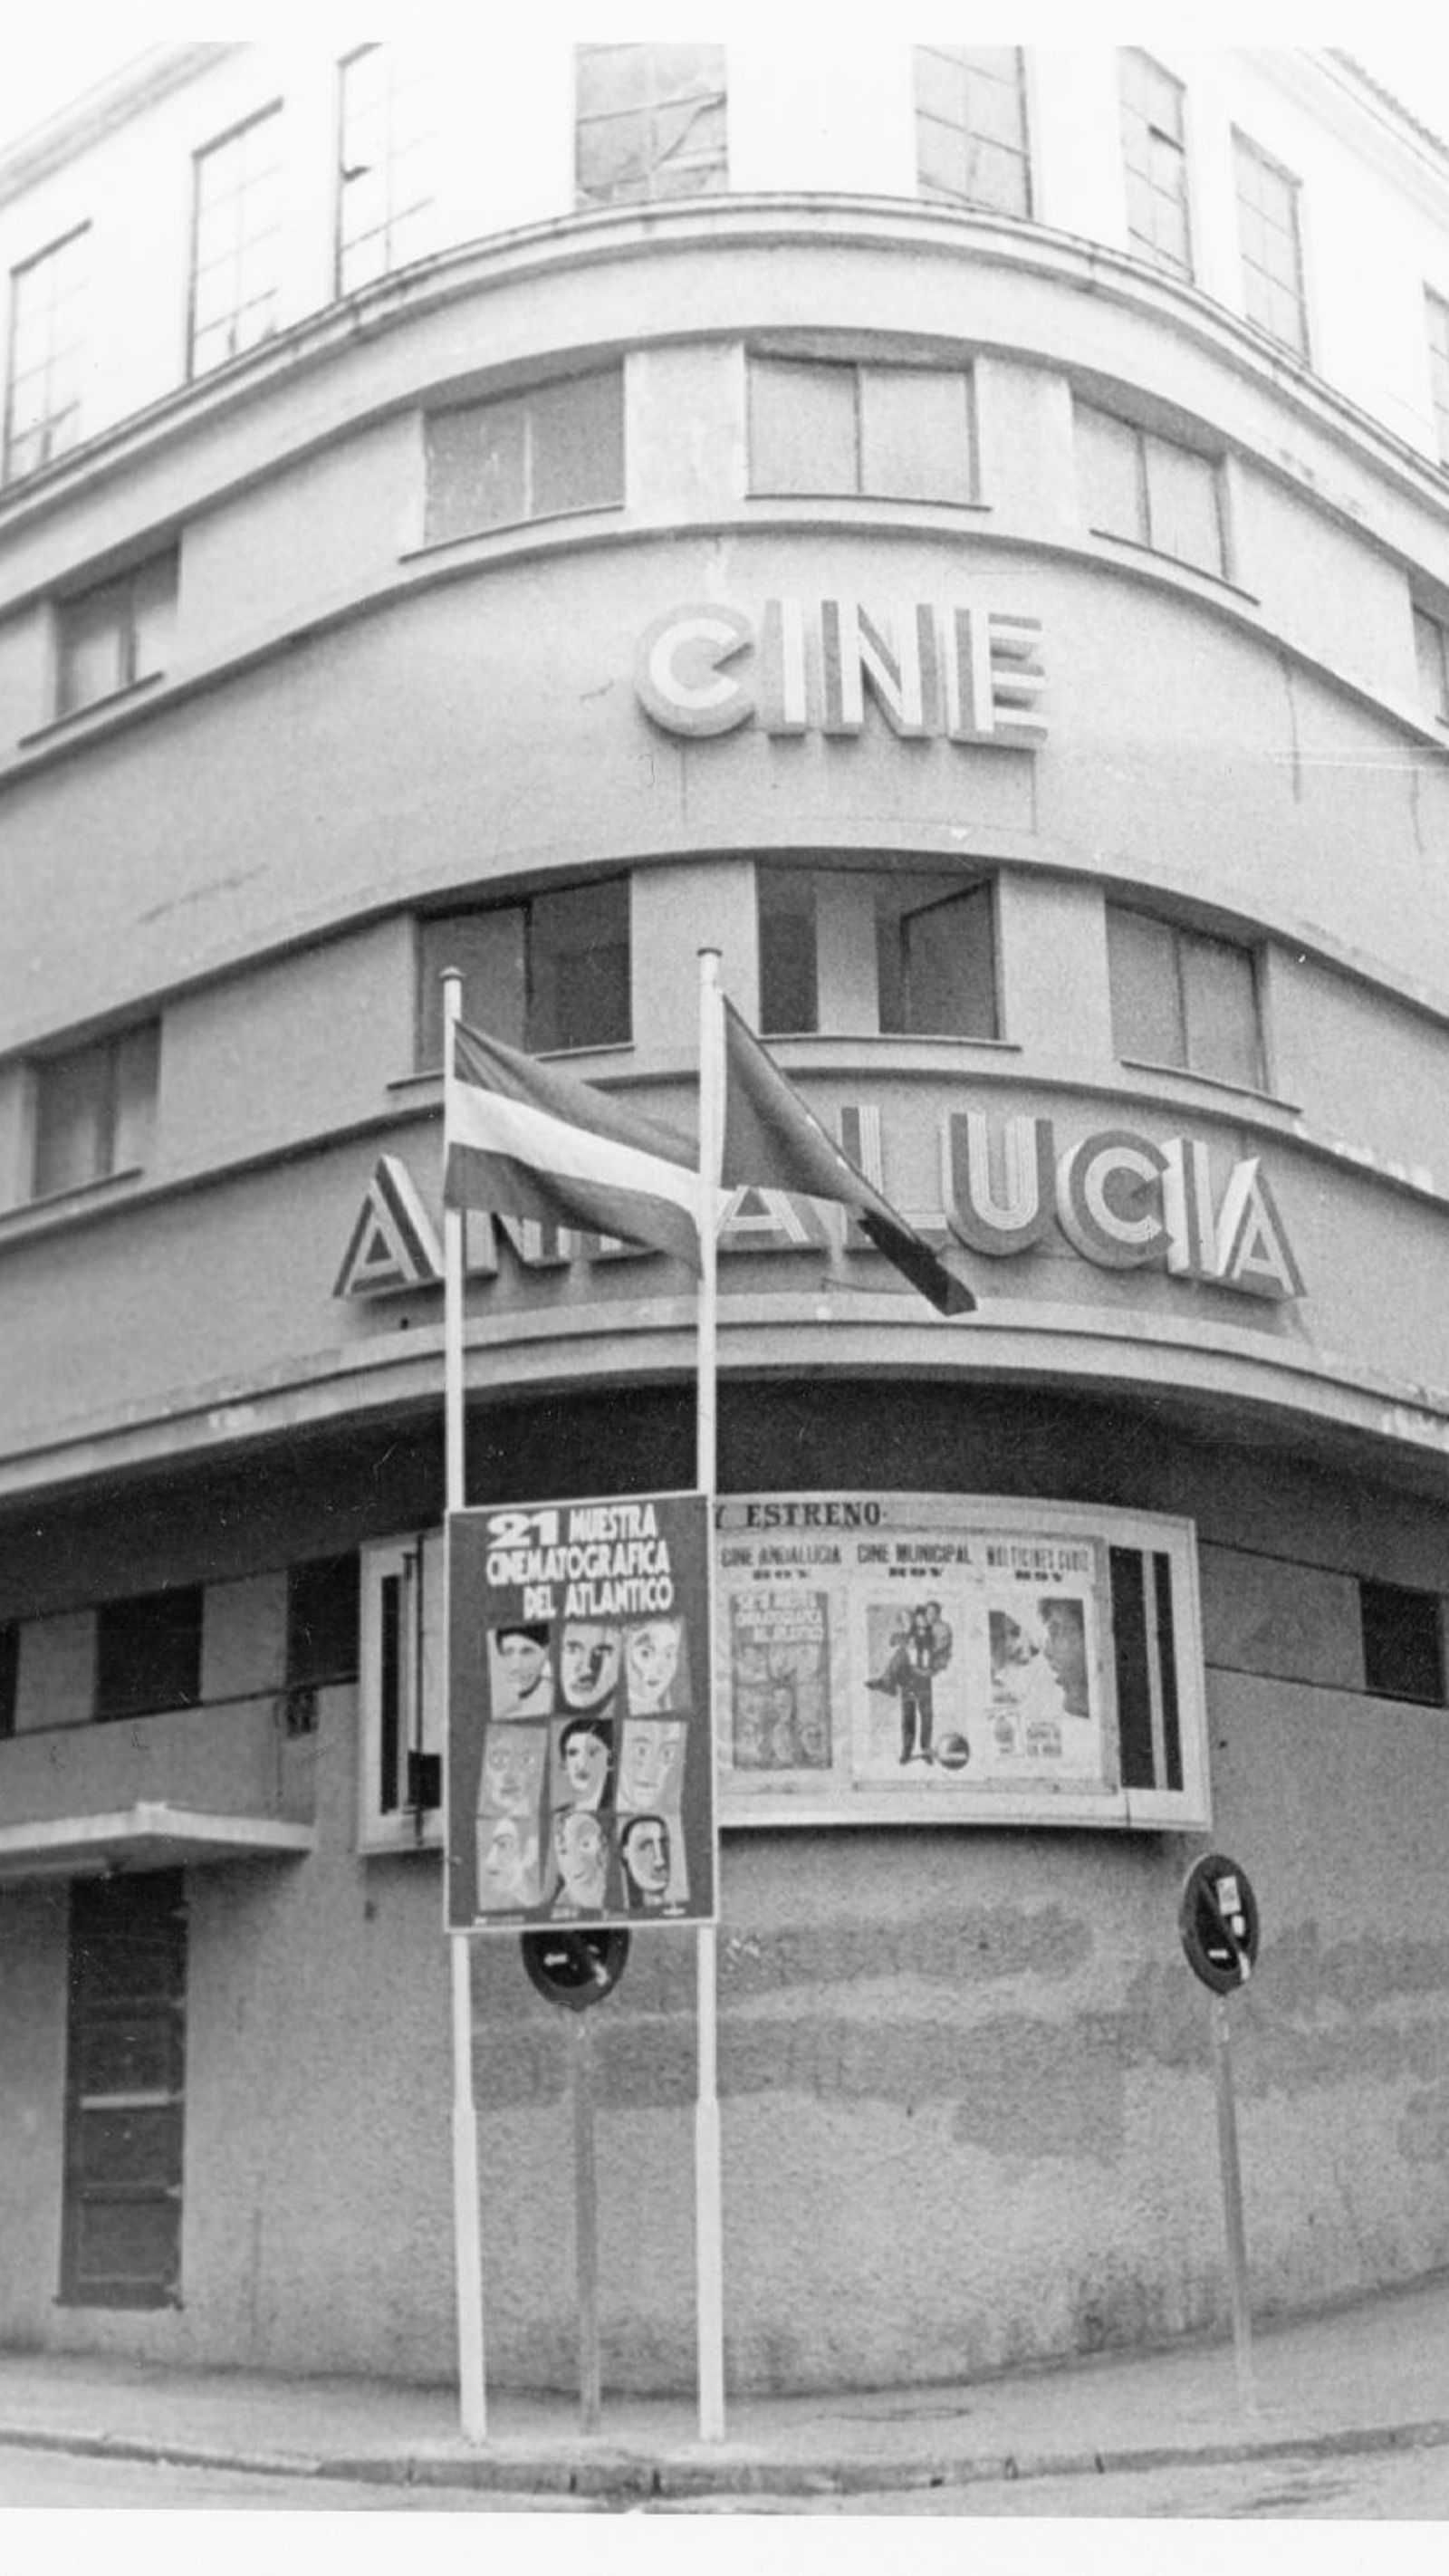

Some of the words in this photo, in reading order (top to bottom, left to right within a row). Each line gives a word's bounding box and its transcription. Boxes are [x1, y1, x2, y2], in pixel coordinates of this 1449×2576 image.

[636, 599, 1048, 747] CINE
[332, 1106, 1307, 1298] AALUCIA
[487, 1510, 559, 1550] 21
[569, 1503, 658, 1542] MUESTRA
[746, 1500, 881, 1529] ESTRENO
[485, 1539, 671, 1586] CINEMATOGRAFICA
[523, 1585, 557, 1620] DEL
[564, 1574, 674, 1617] ATLANTICO
